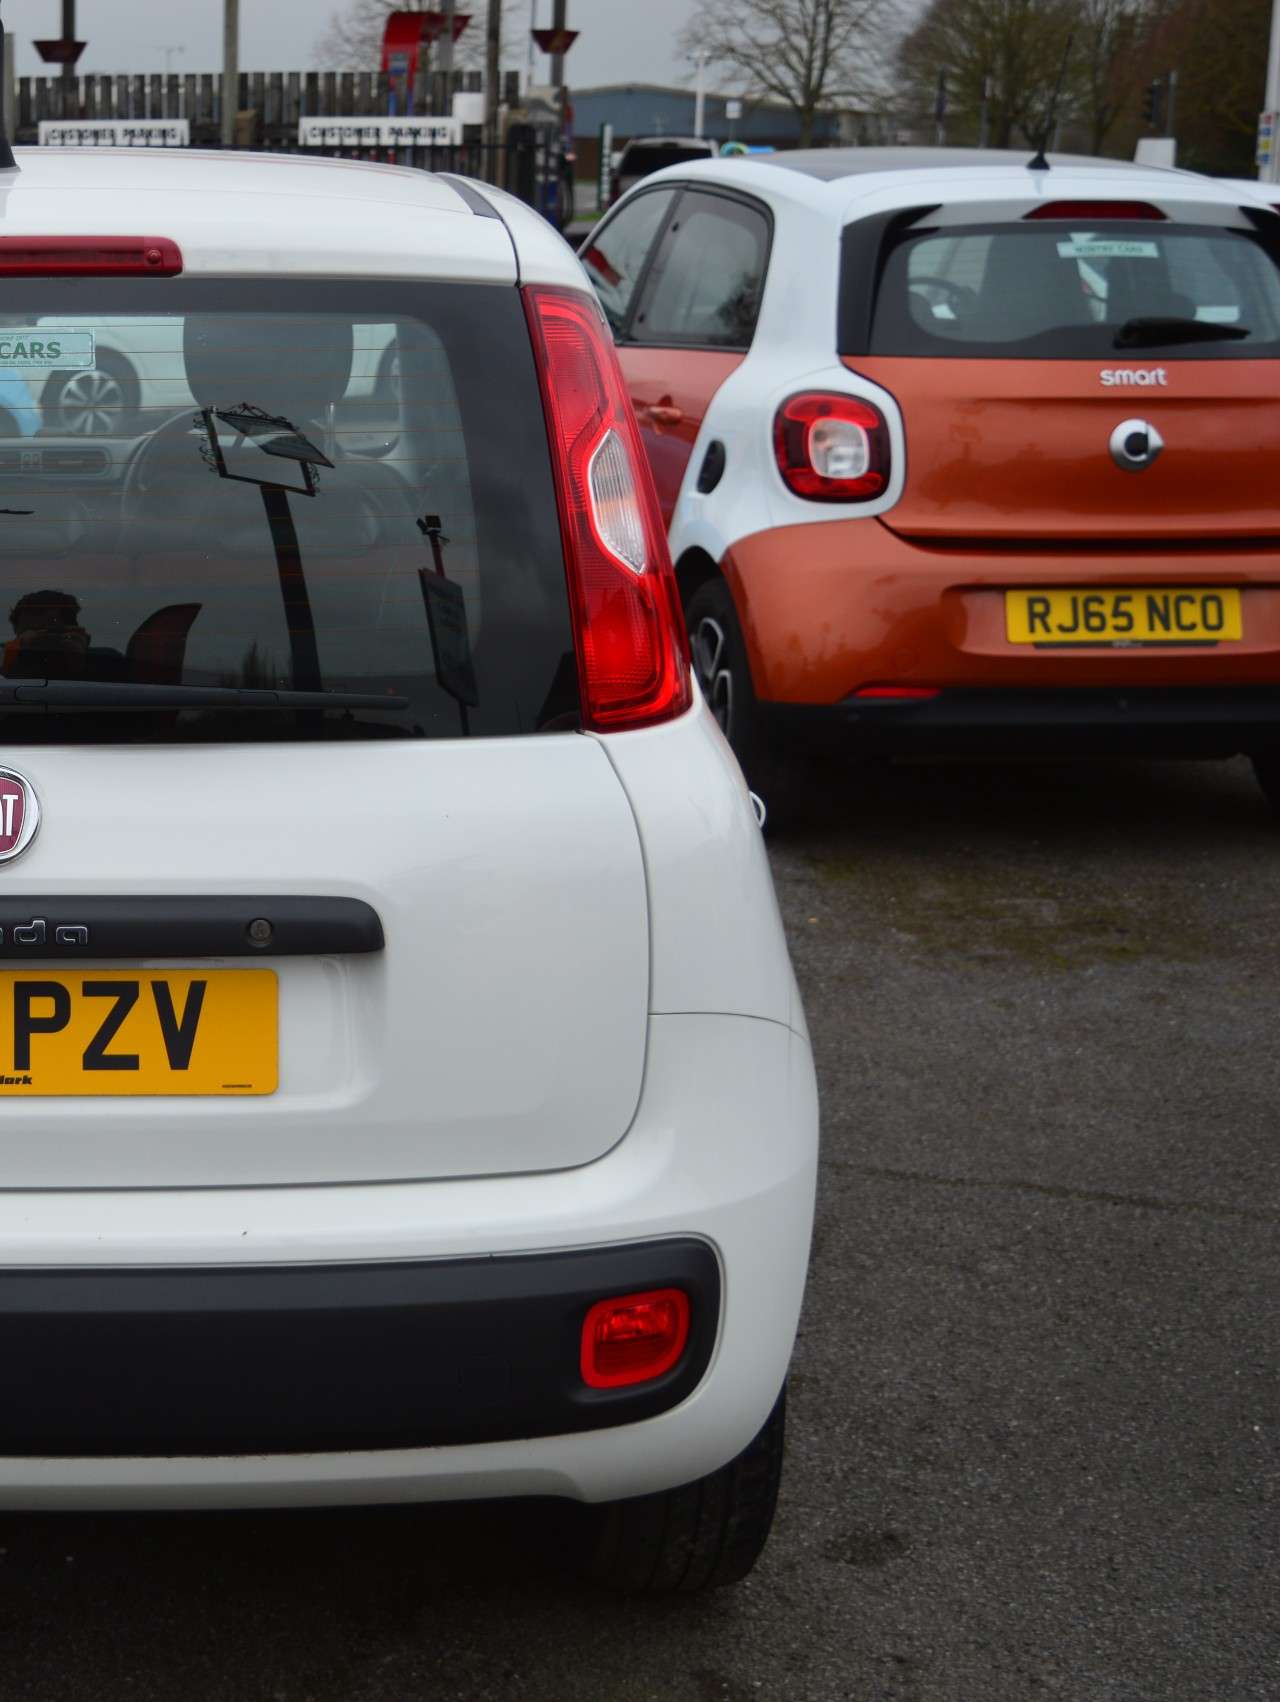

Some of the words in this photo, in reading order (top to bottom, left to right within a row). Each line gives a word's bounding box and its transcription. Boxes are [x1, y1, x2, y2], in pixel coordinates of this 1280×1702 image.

[49, 128, 115, 139] CUSTOMER
[123, 127, 177, 138] PARKING
[309, 127, 380, 138] CUSTOMER
[388, 126, 448, 138] PARKING
[1100, 368, 1167, 386] smart
[1027, 595, 1134, 633] RJ65
[1147, 594, 1224, 632] NCO
[13, 980, 208, 1071] PZV
